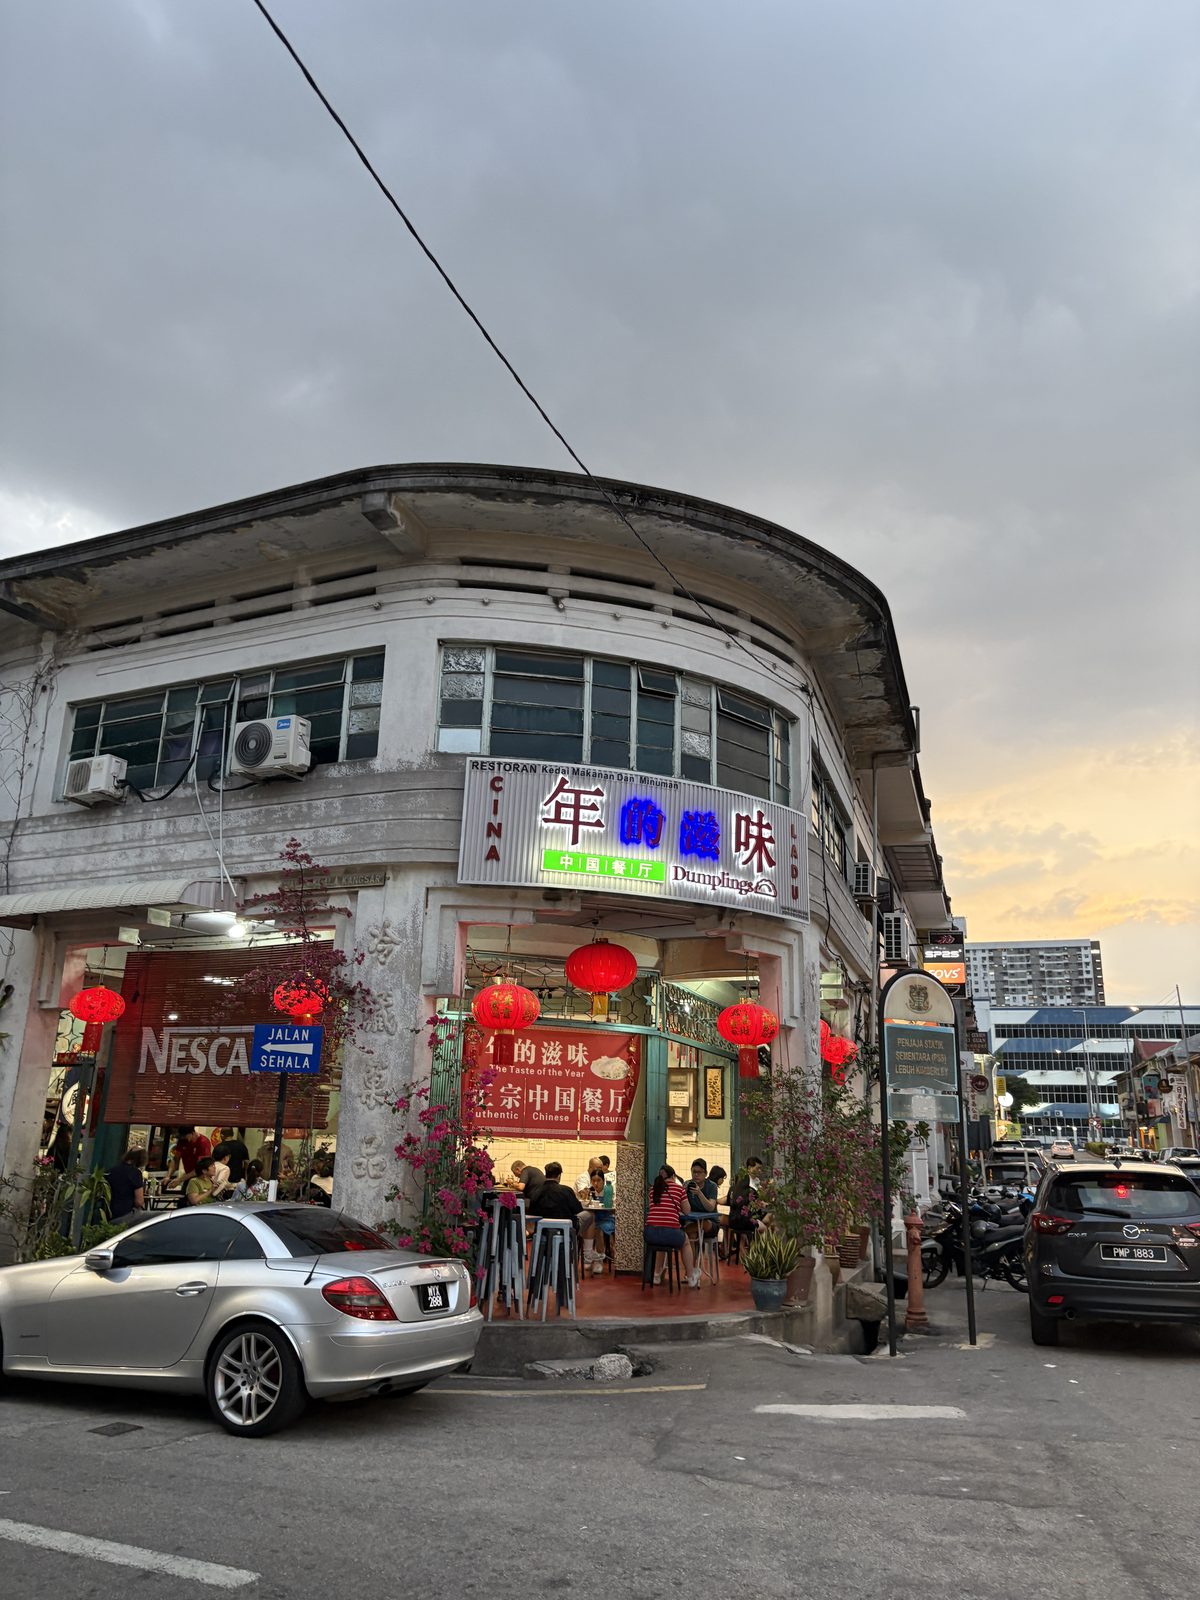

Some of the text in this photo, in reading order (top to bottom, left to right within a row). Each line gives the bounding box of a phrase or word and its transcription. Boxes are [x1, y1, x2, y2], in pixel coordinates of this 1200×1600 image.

[471, 761, 679, 790] RESTORAN Kedai Makanan Dan Minuman
[485, 776, 504, 862] CINA
[542, 777, 777, 873] 年的滋味
[559, 854, 653, 878] 中国餐厅
[790, 823, 799, 901] LADU
[672, 865, 754, 895] Dumplings
[268, 1028, 310, 1041] JALAN
[138, 1026, 251, 1075] NESCA
[260, 1055, 310, 1069] SEHALA
[489, 1064, 585, 1078] The Taste of the Year
[895, 1064, 915, 1074] LEBUH
[475, 1110, 519, 1120] uthentic
[532, 1111, 570, 1122] Chinese
[1113, 1247, 1154, 1259] PMP 1883
